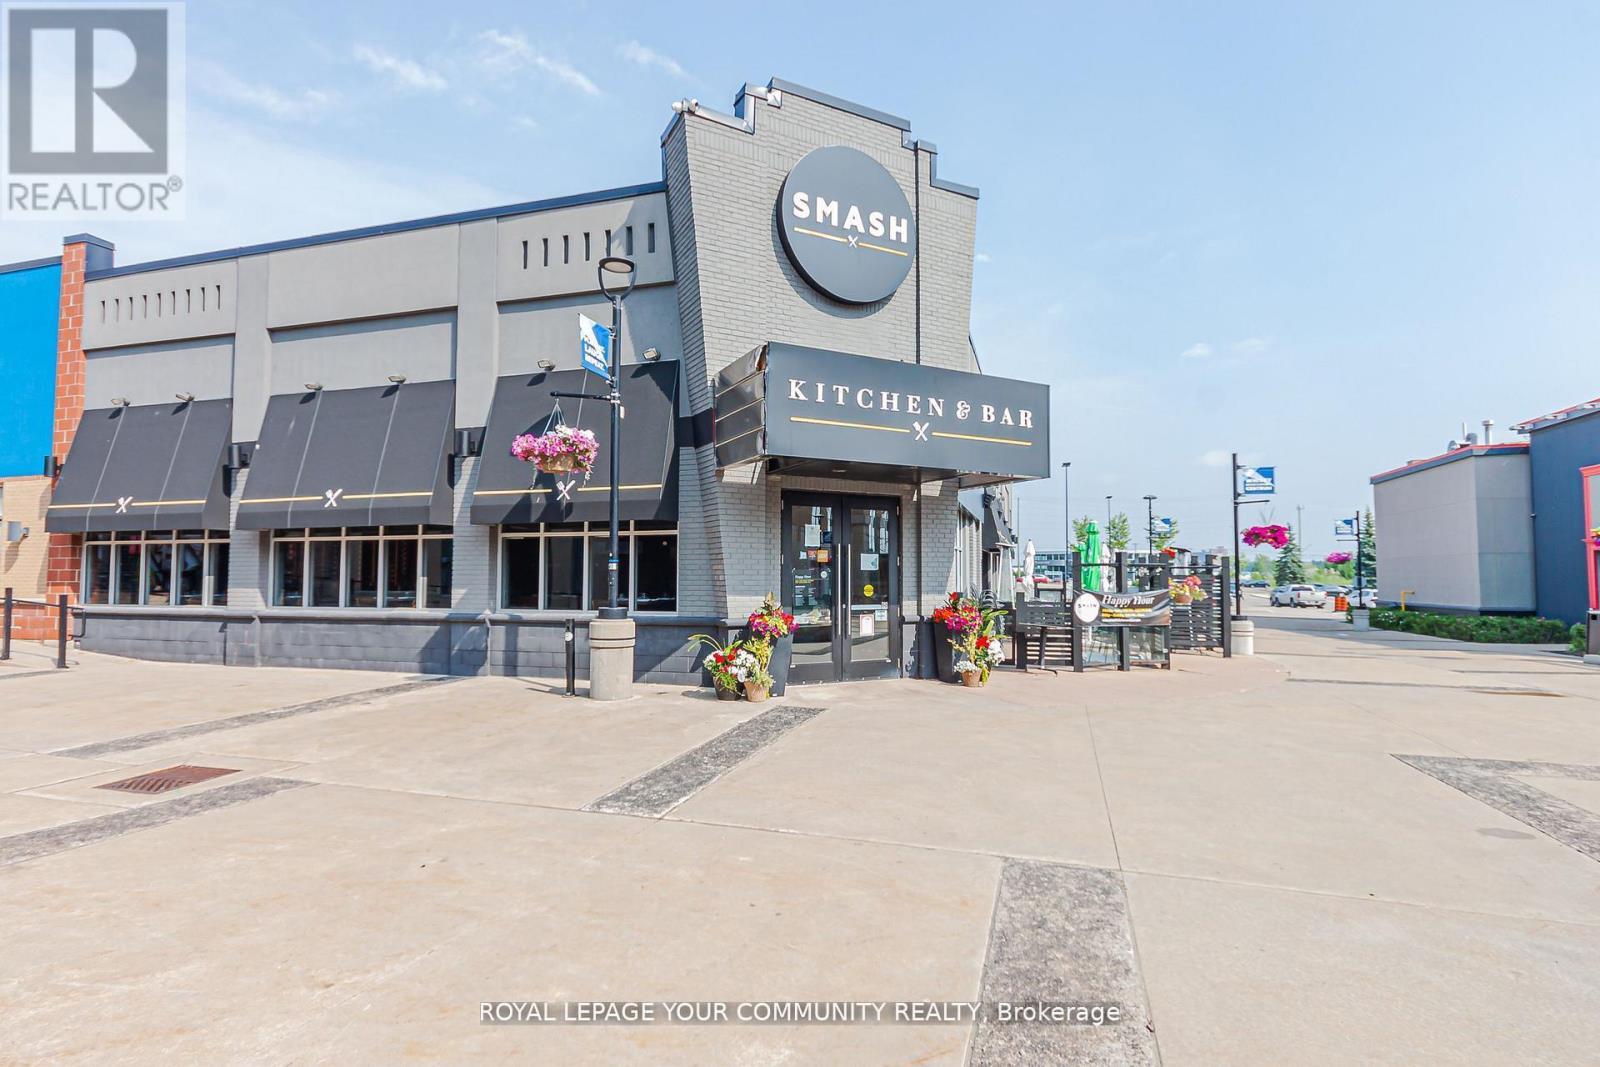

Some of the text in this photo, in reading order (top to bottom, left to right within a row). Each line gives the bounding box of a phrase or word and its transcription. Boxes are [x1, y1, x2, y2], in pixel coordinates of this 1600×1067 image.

[793, 191, 908, 244] SMASH
[788, 379, 1033, 429] KITCHEN & BAR
[1102, 594, 1133, 608] Happy
[1133, 595, 1156, 605] Hour
